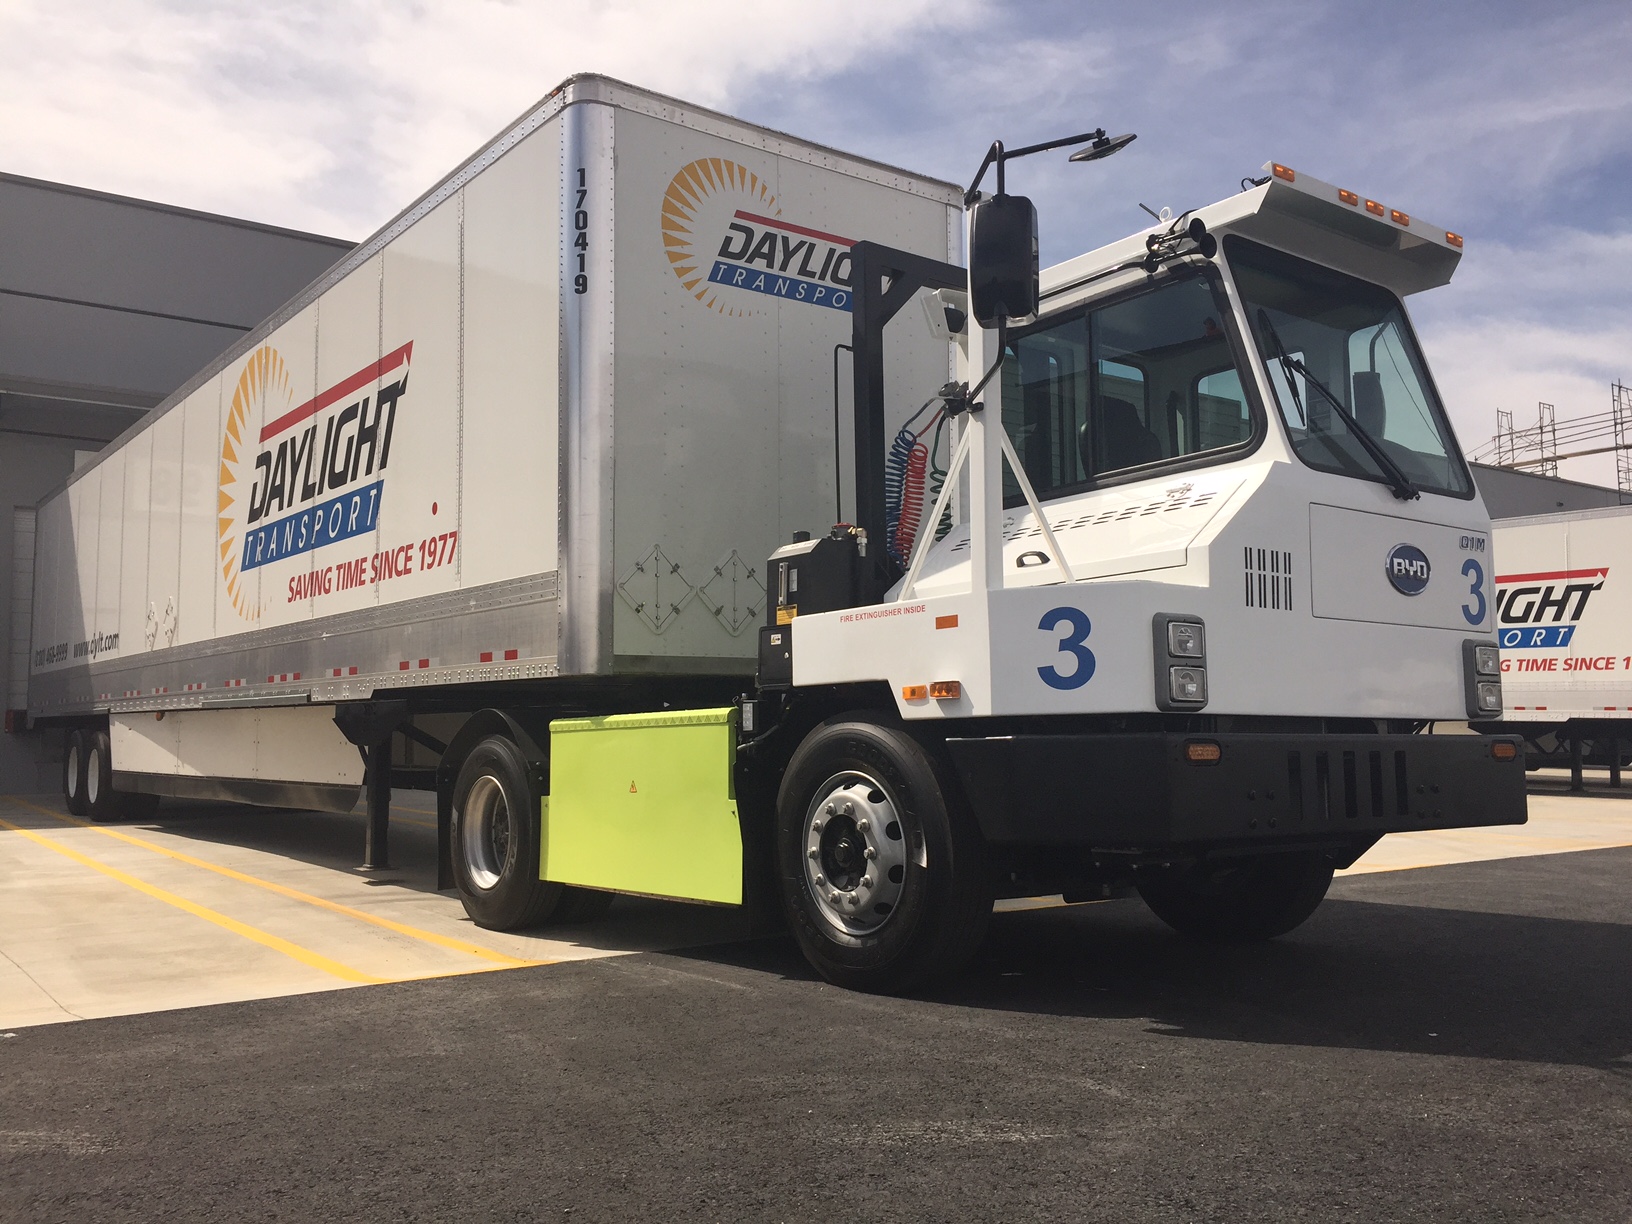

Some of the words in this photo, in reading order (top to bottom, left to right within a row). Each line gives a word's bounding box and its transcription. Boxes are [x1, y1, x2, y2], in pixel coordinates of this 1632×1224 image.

[574, 168, 588, 294] 170419
[247, 370, 409, 525] DAYLIGHT
[247, 488, 377, 566] TRANSPORT
[288, 566, 332, 603] SAVING
[336, 560, 367, 591] TIME
[370, 542, 413, 583] SINCE
[419, 530, 458, 571] 1977
[1393, 557, 1427, 579] BYD
[1461, 558, 1487, 626] 3
[73, 631, 119, 660] www.dylt.com
[840, 614, 854, 623] FIRE
[855, 608, 902, 621] EXTINGUISHER
[903, 605, 926, 615] INSIDE
[1037, 606, 1096, 690] 3
[1517, 658, 1558, 672] TIME
[1563, 657, 1616, 671] SINCE
